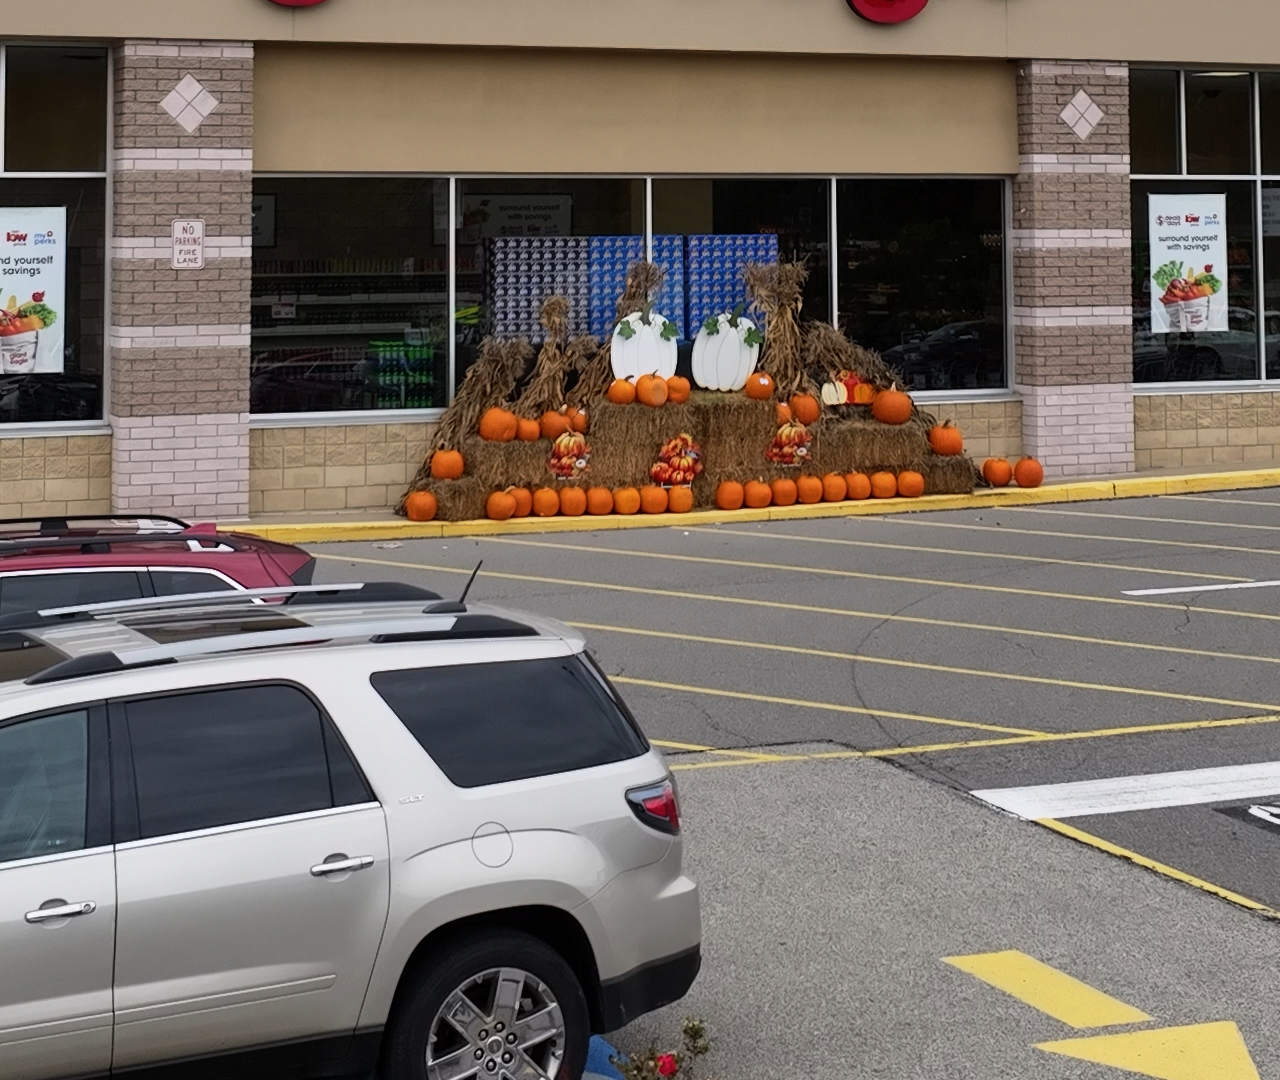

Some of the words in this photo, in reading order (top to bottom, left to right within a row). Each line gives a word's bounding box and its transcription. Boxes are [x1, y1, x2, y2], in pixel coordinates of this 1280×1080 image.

[182, 225, 195, 235] NO
[6, 232, 28, 243] low
[34, 238, 56, 246] perks
[175, 236, 201, 247] PARKING
[1191, 234, 1218, 243] yourself
[1183, 244, 1210, 252] savings
[14, 255, 54, 266] yourself
[176, 256, 199, 264] LANE
[2, 266, 41, 277] savings
[398, 793, 425, 804] SLT
